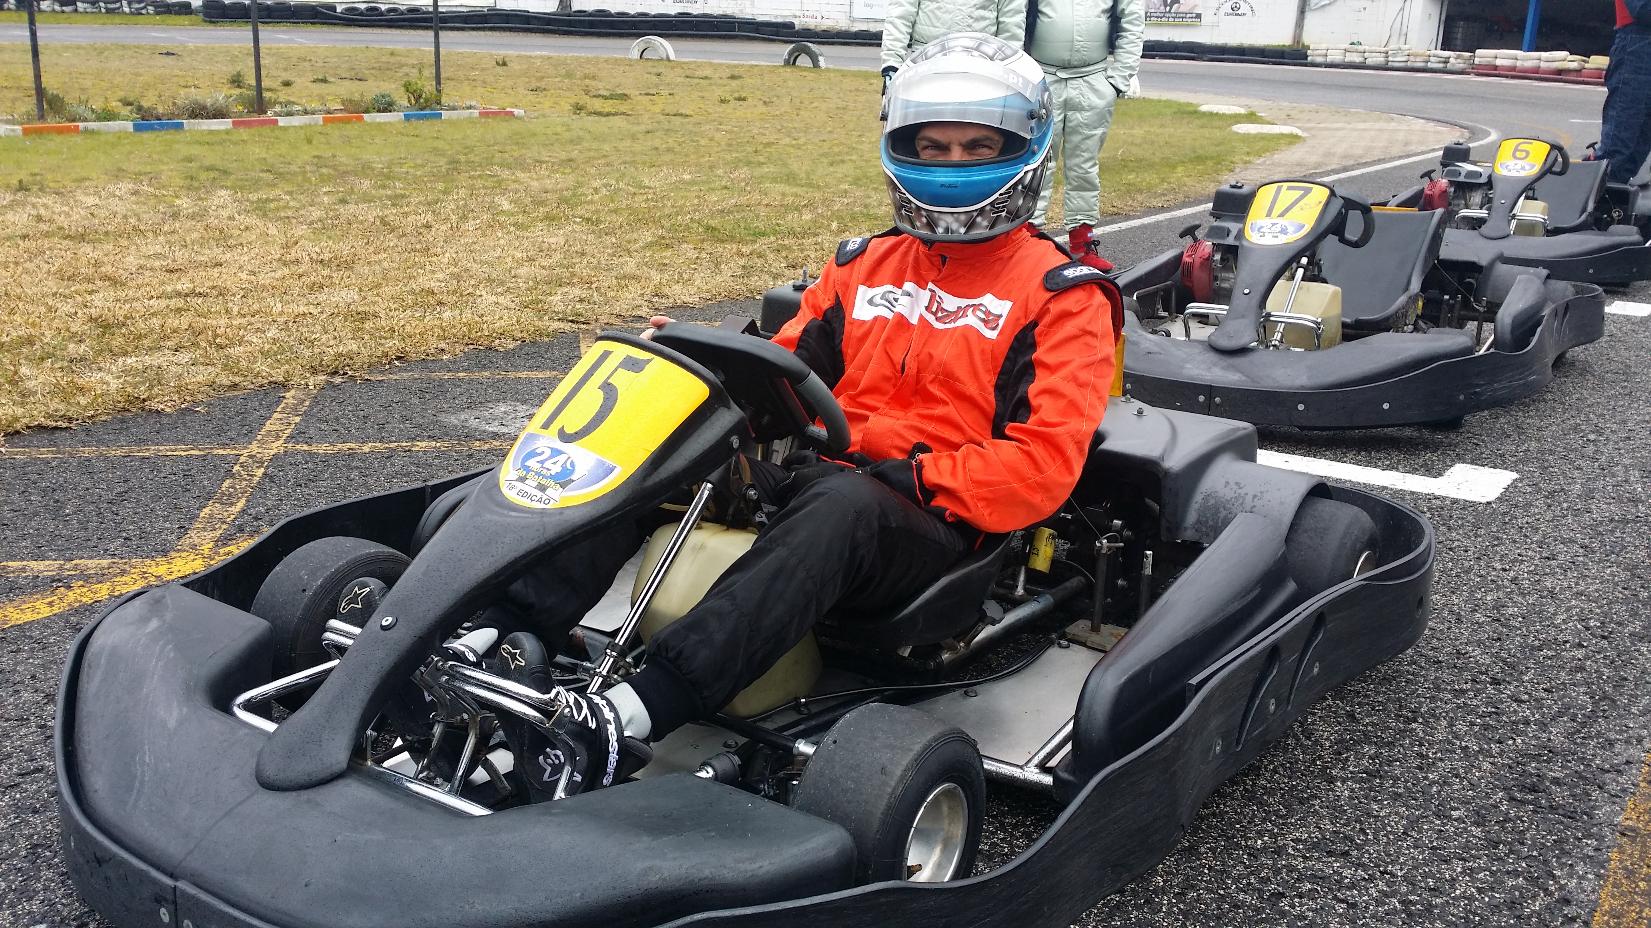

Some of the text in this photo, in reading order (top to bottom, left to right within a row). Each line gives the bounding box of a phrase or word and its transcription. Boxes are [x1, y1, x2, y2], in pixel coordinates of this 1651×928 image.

[1511, 141, 1534, 160] 6
[1264, 184, 1314, 219] 17
[539, 349, 655, 444] 15
[524, 445, 572, 475] 24
[516, 489, 551, 506] EDIÇÃO
